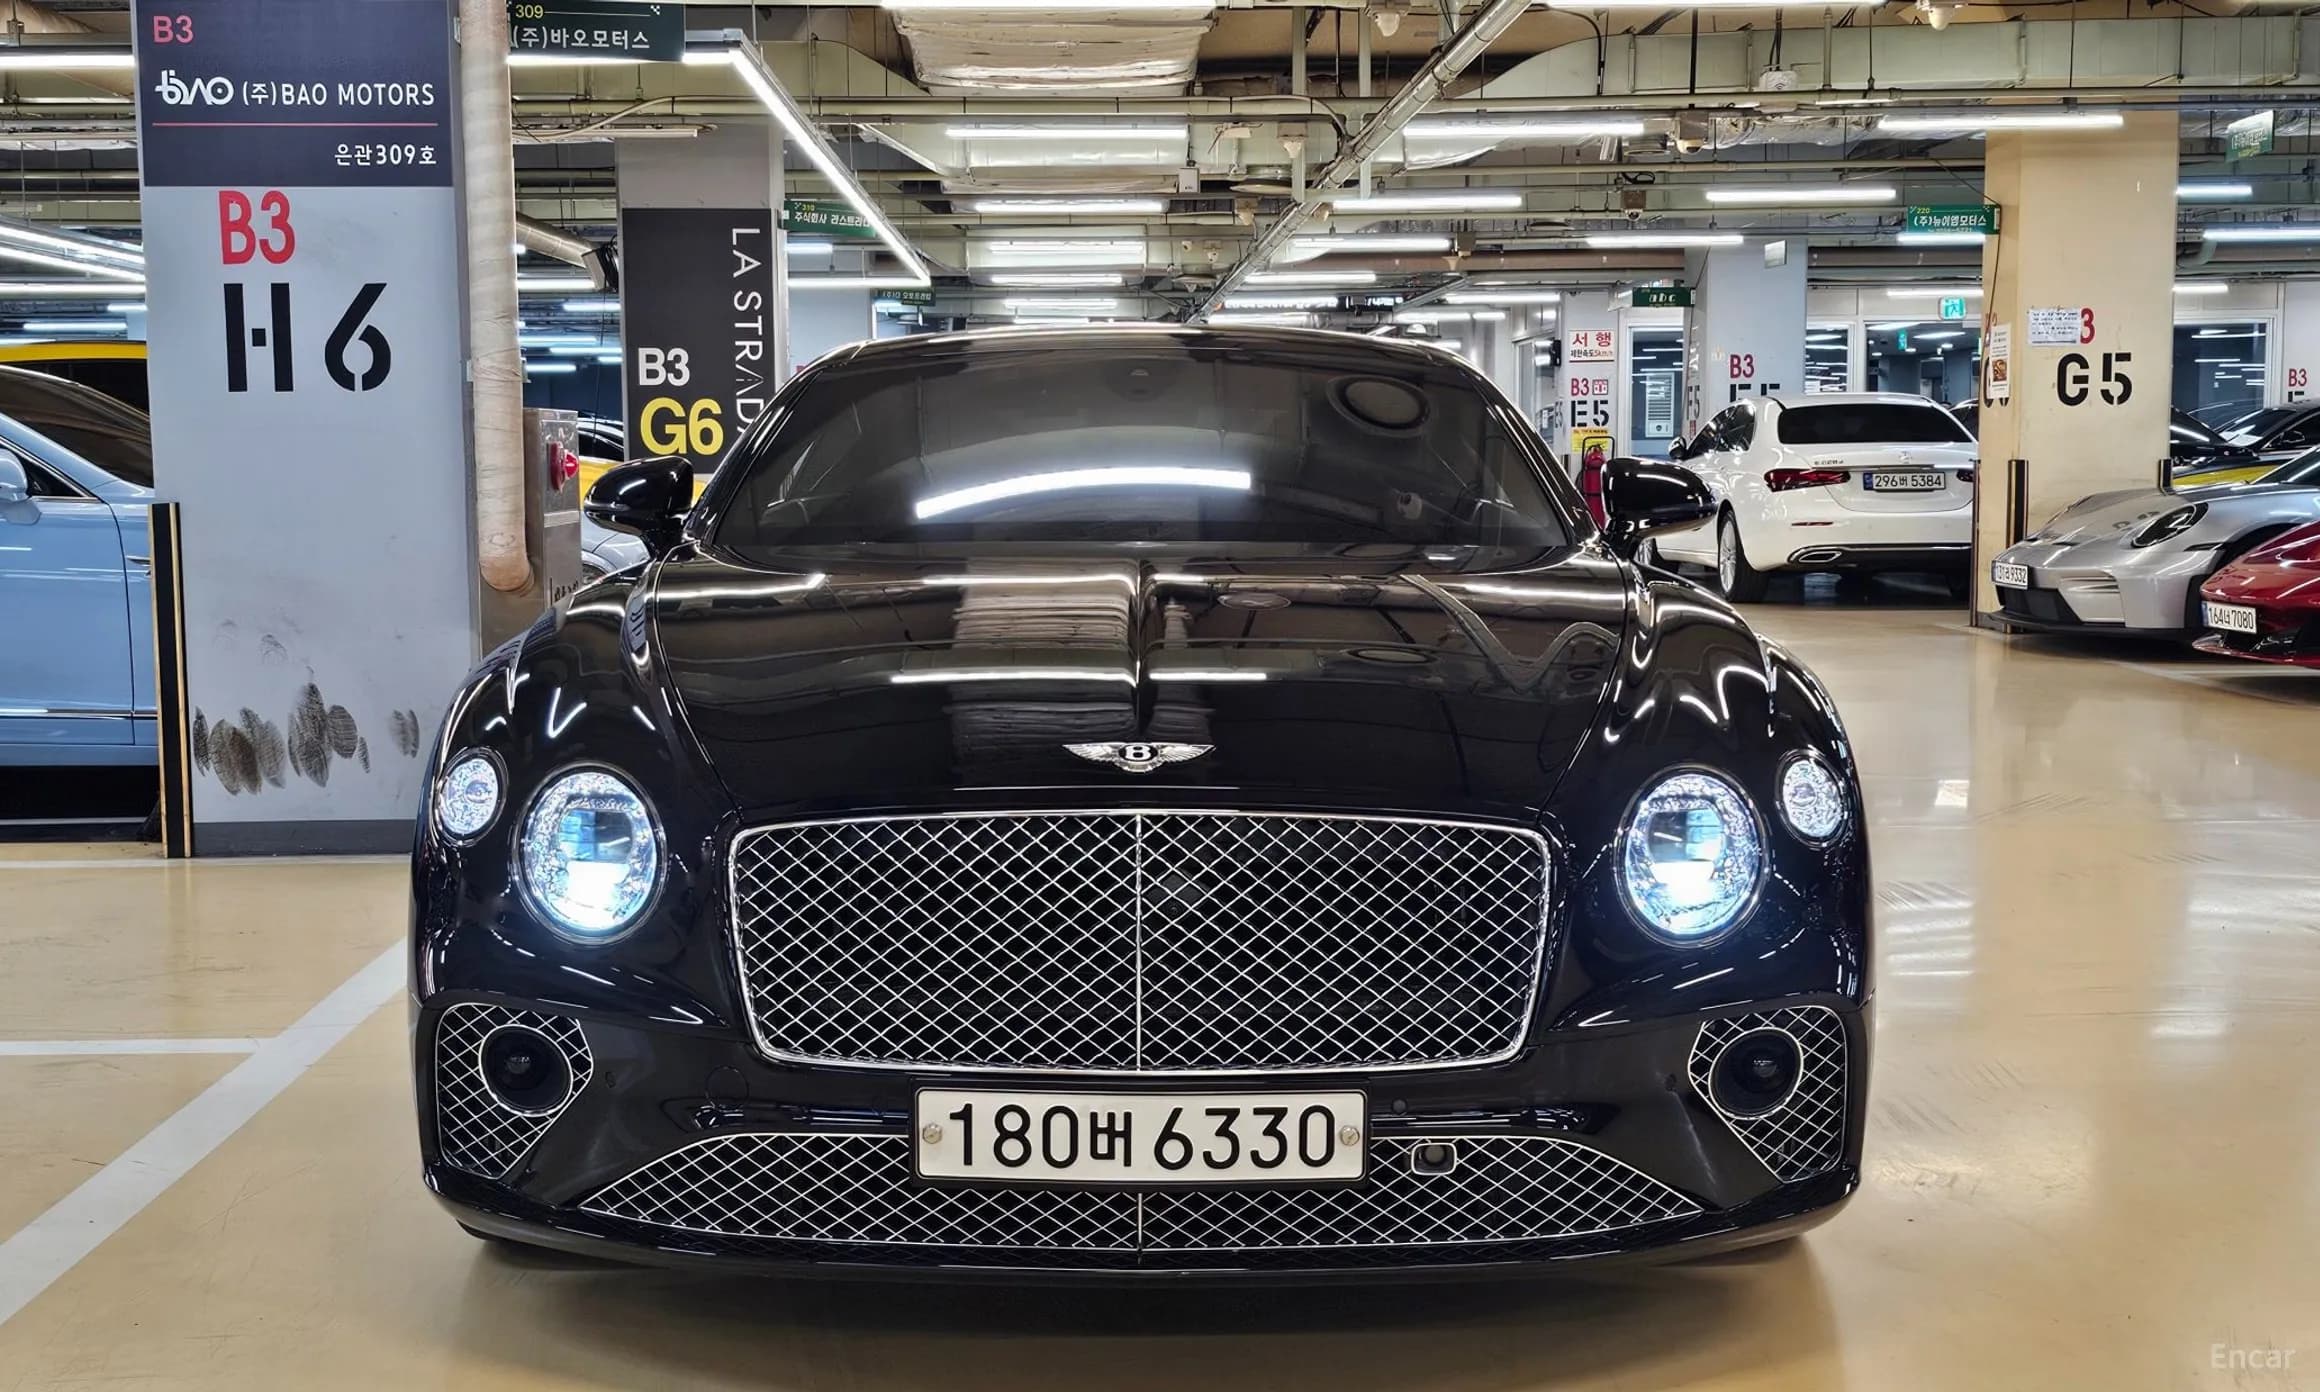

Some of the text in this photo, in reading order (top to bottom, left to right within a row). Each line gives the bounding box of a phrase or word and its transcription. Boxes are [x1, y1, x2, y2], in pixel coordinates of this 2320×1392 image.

[515, 4, 544, 19] 309
[153, 15, 194, 43] B3
[513, 26, 650, 50] (주)바오모터스
[338, 83, 435, 106] MOTORS
[219, 190, 296, 265] B3
[732, 228, 764, 433] LA STRAD
[638, 347, 690, 387] B3
[1730, 353, 1755, 379] B3
[2288, 368, 2307, 387] B3
[1571, 377, 1590, 396] B3
[640, 397, 724, 456] G6
[1571, 400, 1610, 428] E5
[1911, 475, 1942, 488] 5384
[2231, 609, 2254, 630] 7080
[949, 1103, 1336, 1171] 180버 6330
